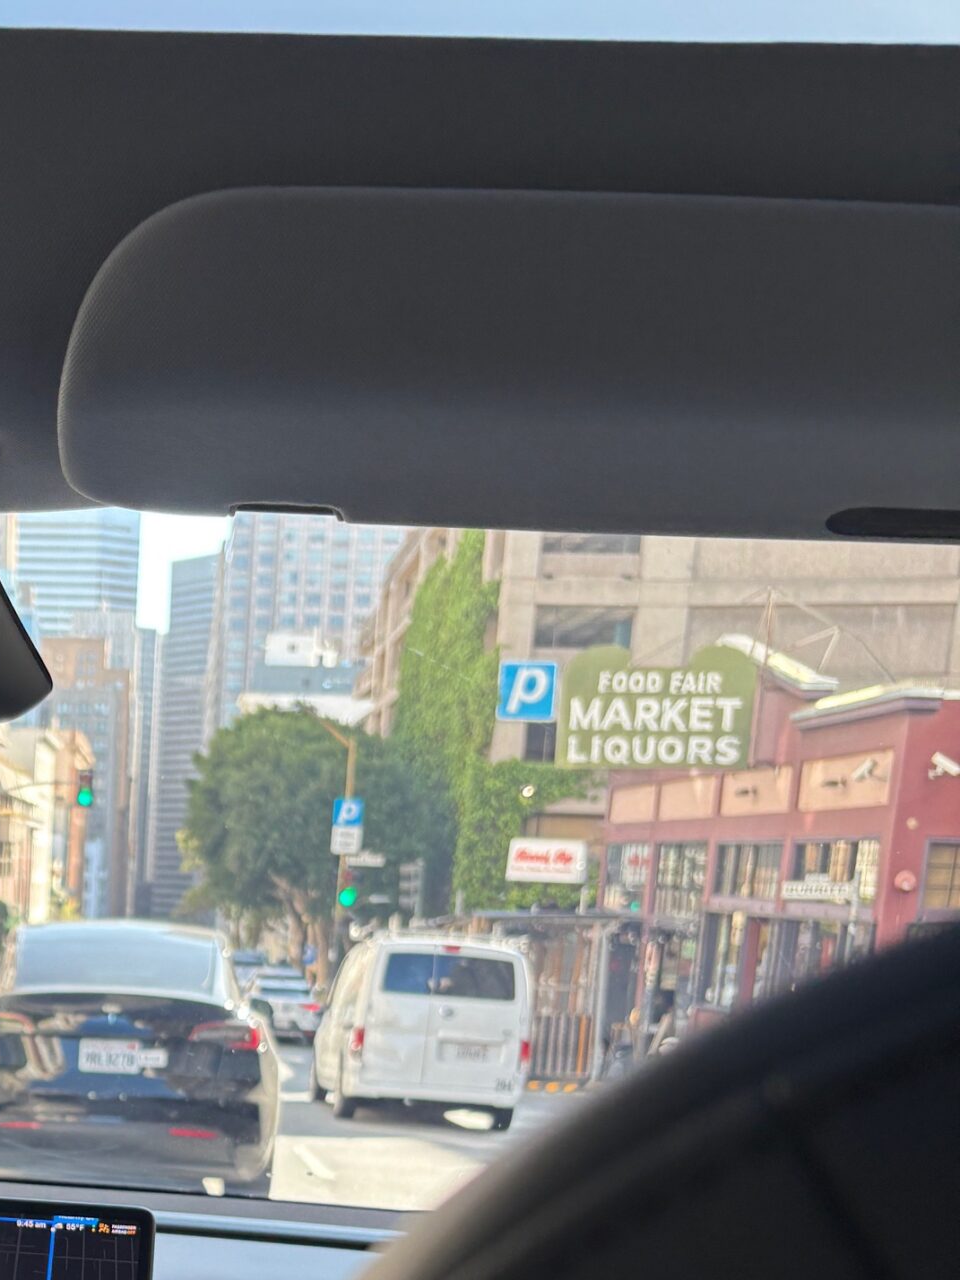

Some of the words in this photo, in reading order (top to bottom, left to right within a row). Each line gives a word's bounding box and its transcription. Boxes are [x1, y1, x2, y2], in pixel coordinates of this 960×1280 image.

[506, 666, 548, 714] P
[597, 670, 663, 694] FOOD
[669, 671, 723, 695] FAIR
[568, 697, 743, 732] MARKET
[566, 734, 742, 765] LIQUORS
[336, 800, 359, 825] P
[34, 1221, 47, 1229] am
